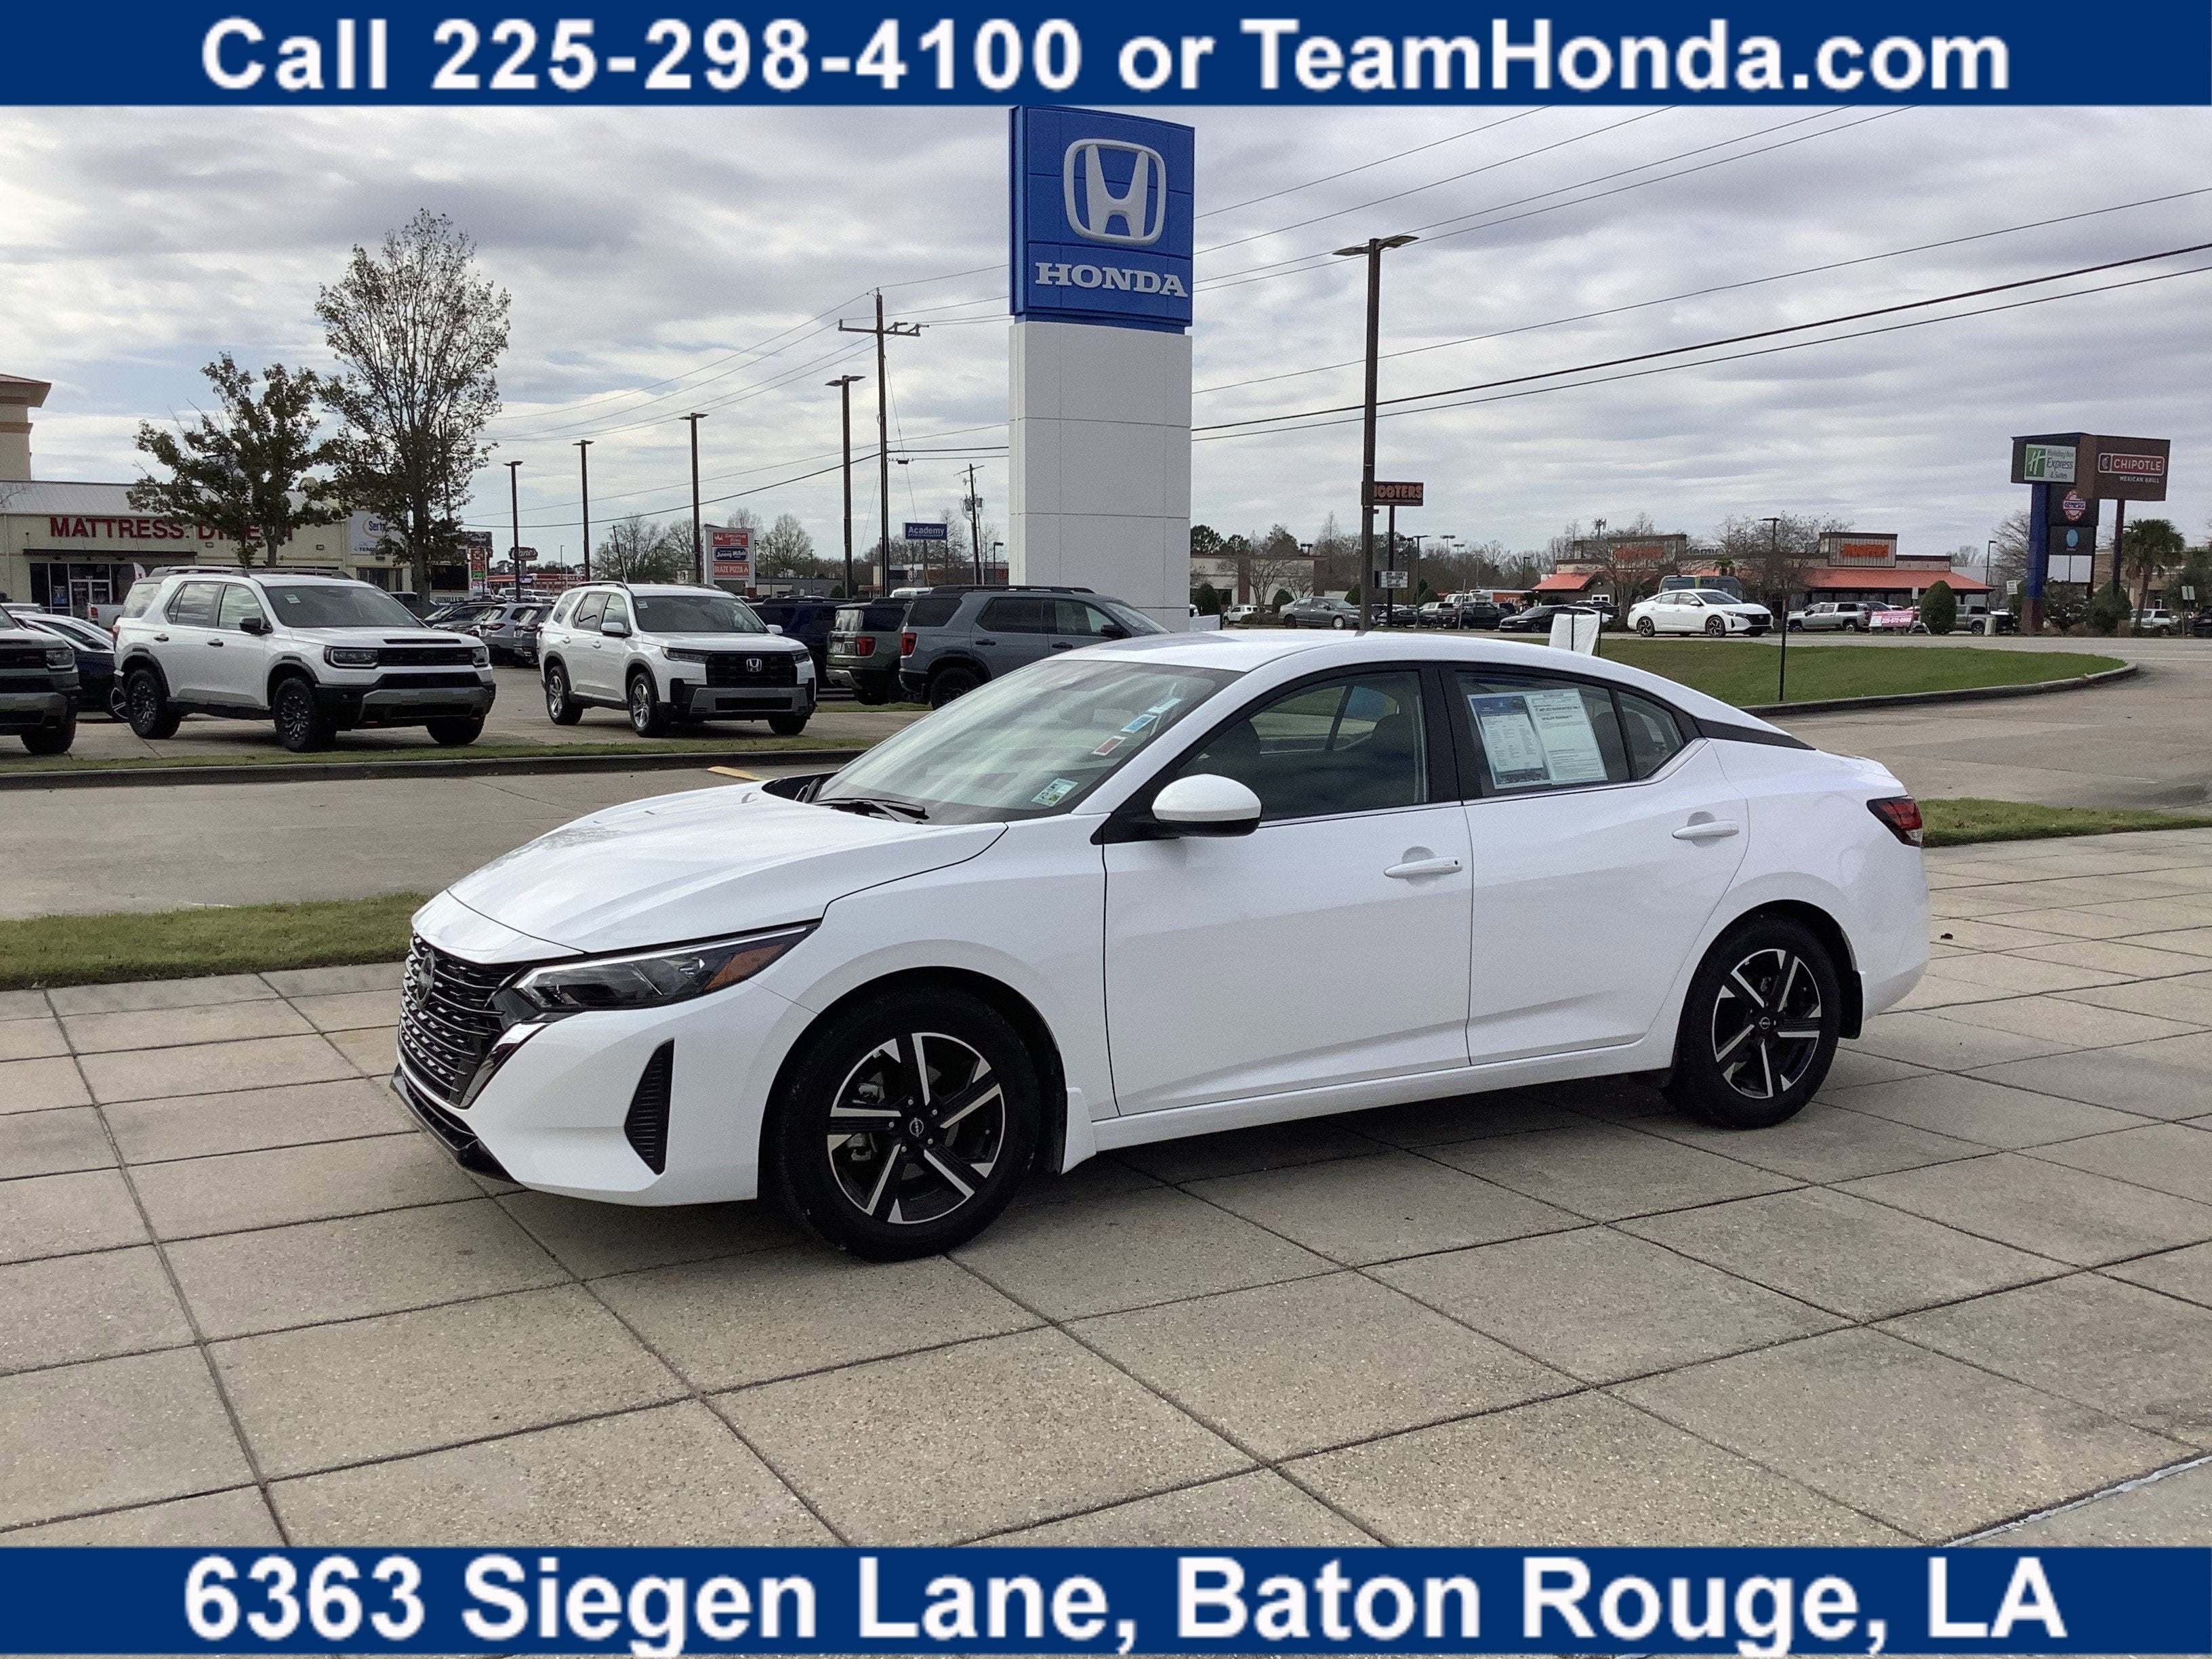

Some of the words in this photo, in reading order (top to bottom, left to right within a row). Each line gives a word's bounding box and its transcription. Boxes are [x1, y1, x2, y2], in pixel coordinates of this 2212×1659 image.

[1035, 262, 1188, 298] HONDA
[2047, 457, 2073, 471] Express
[2114, 459, 2162, 470] CHIPOTLE
[50, 516, 184, 539] MATTRESS
[908, 526, 945, 536] Academy
